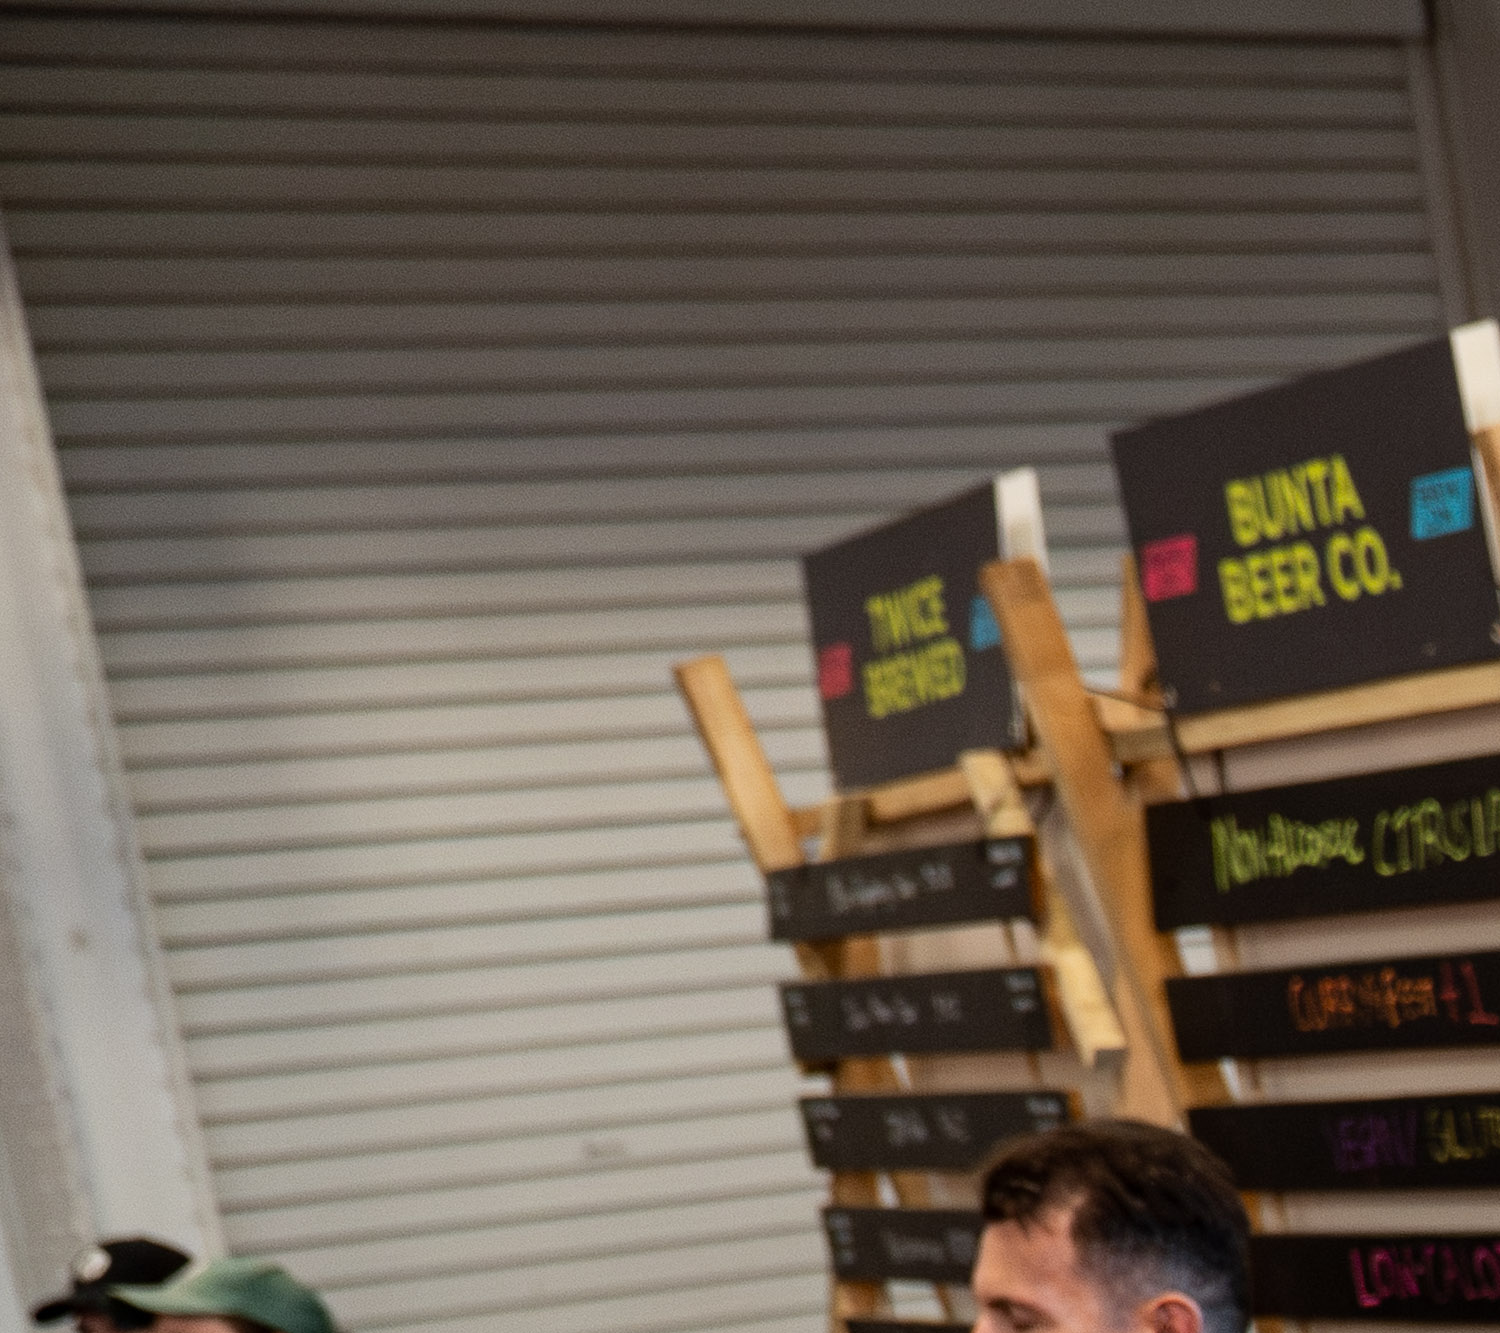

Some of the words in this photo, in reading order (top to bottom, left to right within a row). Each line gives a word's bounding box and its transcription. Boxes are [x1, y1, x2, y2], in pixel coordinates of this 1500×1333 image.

[1224, 452, 1366, 547] BUNTA
[864, 573, 948, 650] TWICE
[1218, 541, 1327, 624] BEER
[1325, 525, 1403, 601] CO.
[862, 635, 968, 720] BREWED
